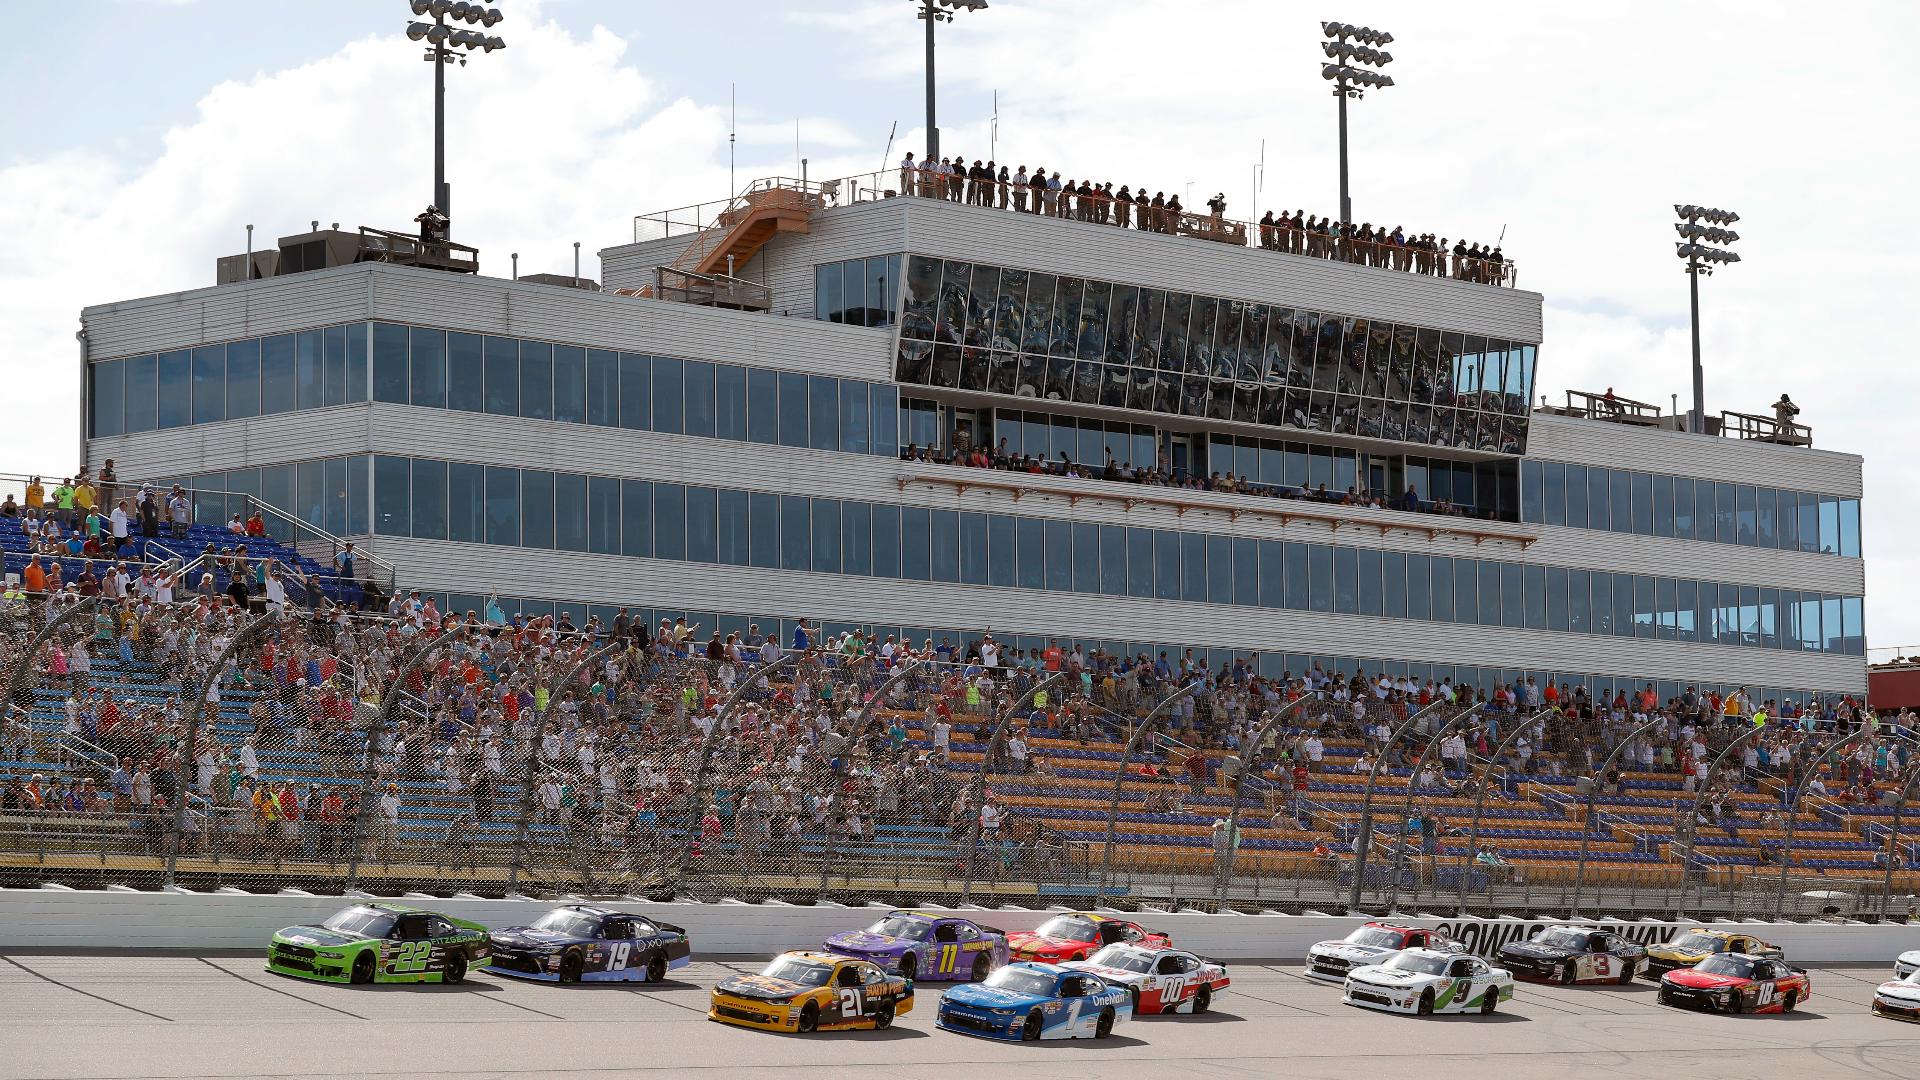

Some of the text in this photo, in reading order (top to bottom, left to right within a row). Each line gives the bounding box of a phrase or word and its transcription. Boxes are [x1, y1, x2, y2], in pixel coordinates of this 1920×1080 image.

[431, 935, 481, 945] FITZGERALD
[394, 941, 432, 972] 22
[606, 942, 631, 972] 19
[939, 943, 958, 973] 11
[1593, 953, 1610, 977] 3
[840, 988, 863, 1018] 21
[865, 984, 887, 997] SOUTH
[1092, 992, 1124, 1007] OneMain
[1160, 977, 1186, 1004] 00
[1452, 979, 1473, 1004] 9
[1757, 982, 1775, 1006] 18
[1065, 998, 1083, 1031] 1
